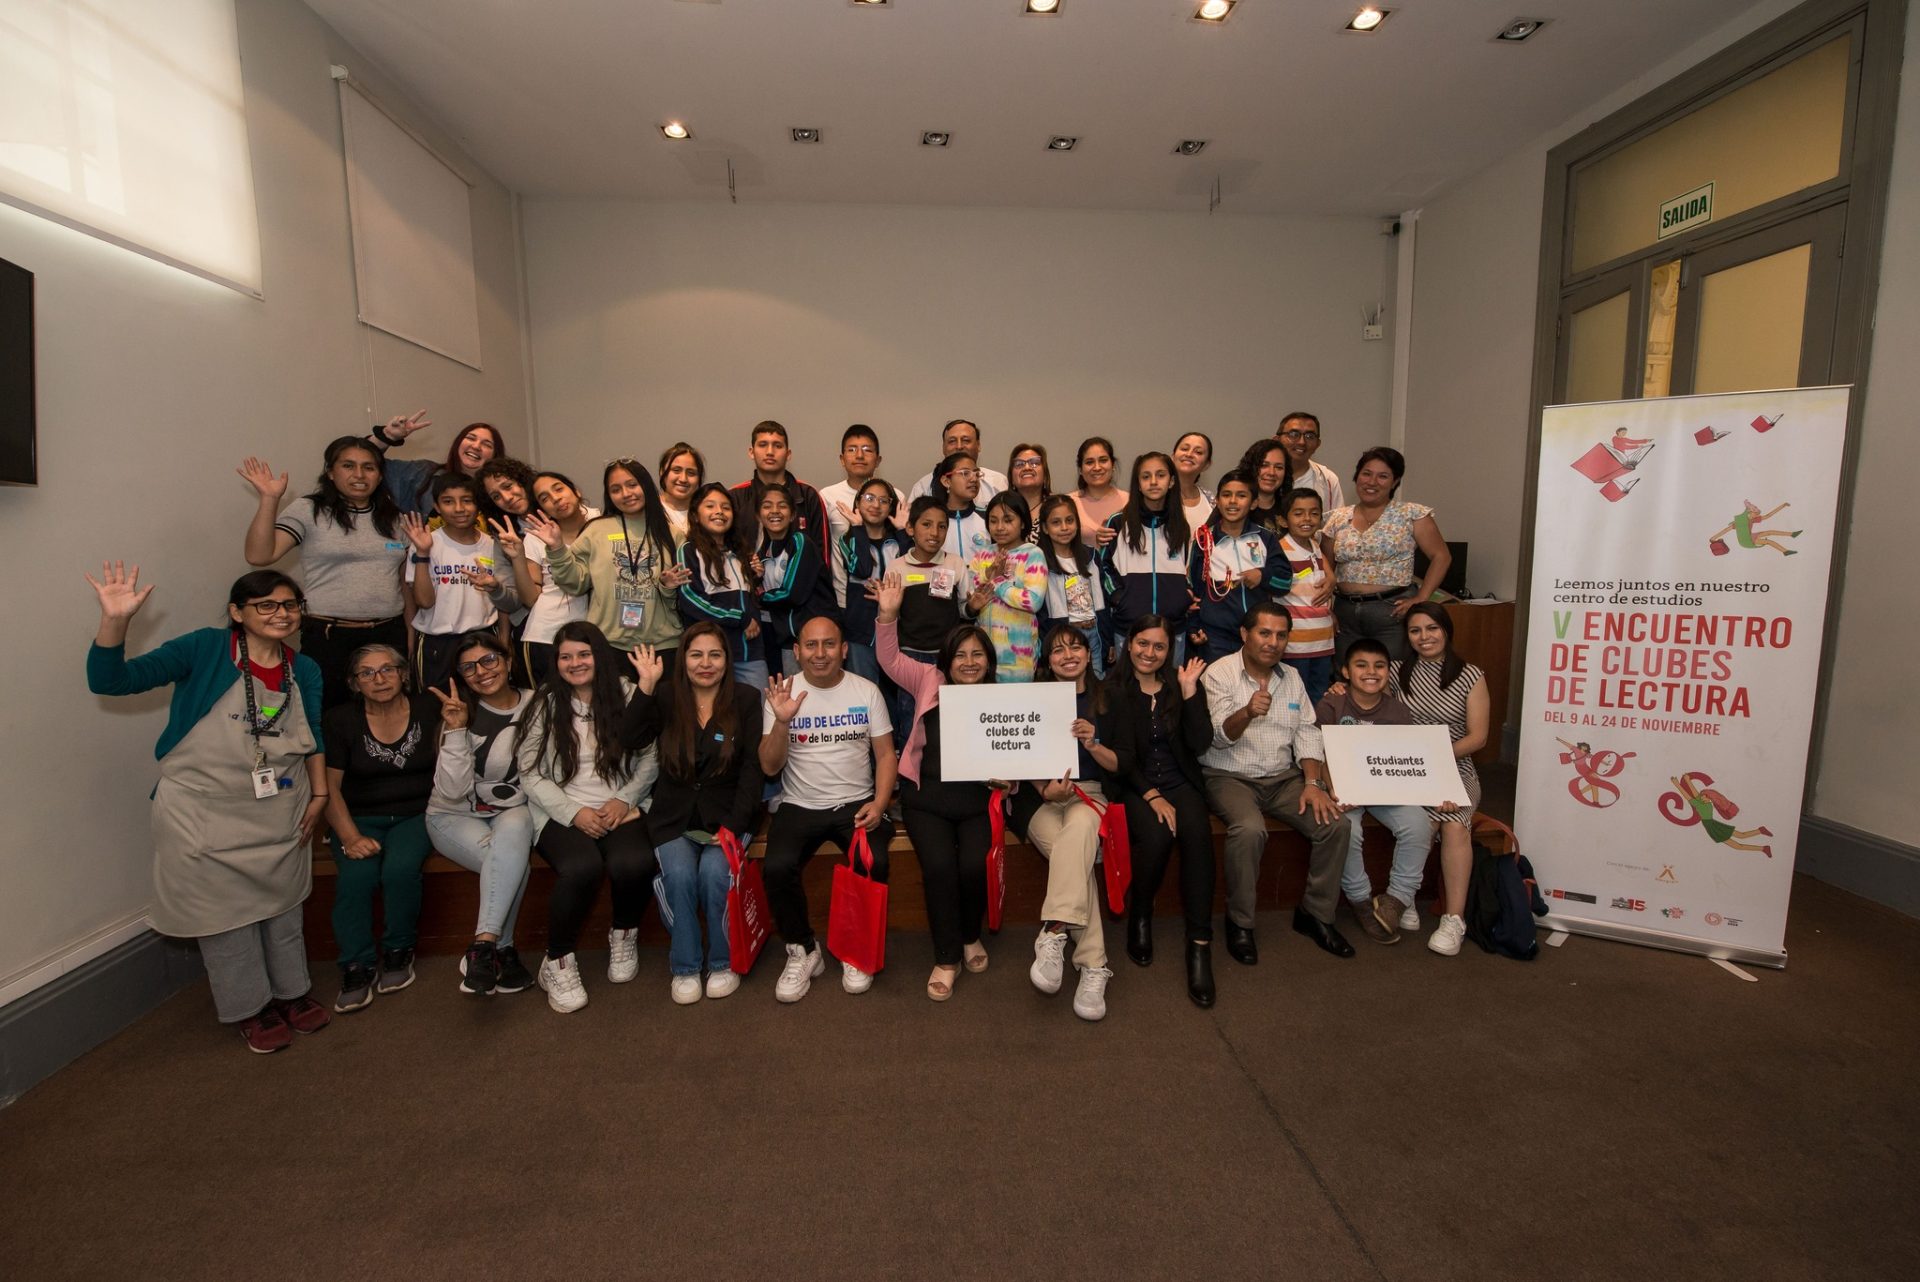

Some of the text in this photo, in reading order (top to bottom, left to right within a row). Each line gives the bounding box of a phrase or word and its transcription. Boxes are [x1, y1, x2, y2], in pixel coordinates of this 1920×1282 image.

[1662, 195, 1707, 229] SALIDA
[450, 577, 459, 585] de
[1554, 579, 1770, 593] Leemos juntos en nuestro
[1553, 593, 1703, 606] centro de estudios
[1553, 611, 1792, 649] V ENCUENTRO
[1550, 643, 1732, 681] DE CLUBES
[1547, 675, 1750, 718] DE LECTURA
[815, 716, 828, 728] DE
[829, 713, 869, 727] LECTURA
[979, 711, 1041, 723] Gestores de
[1544, 711, 1721, 736] DEL 9 AL 24 DE NOVIEMBRE
[808, 733, 820, 743] de
[821, 732, 833, 742] las
[985, 725, 1035, 737] clubes de
[991, 739, 1031, 750] lectura
[1366, 755, 1424, 766] Estudiantes
[1370, 767, 1426, 777] de escuelas
